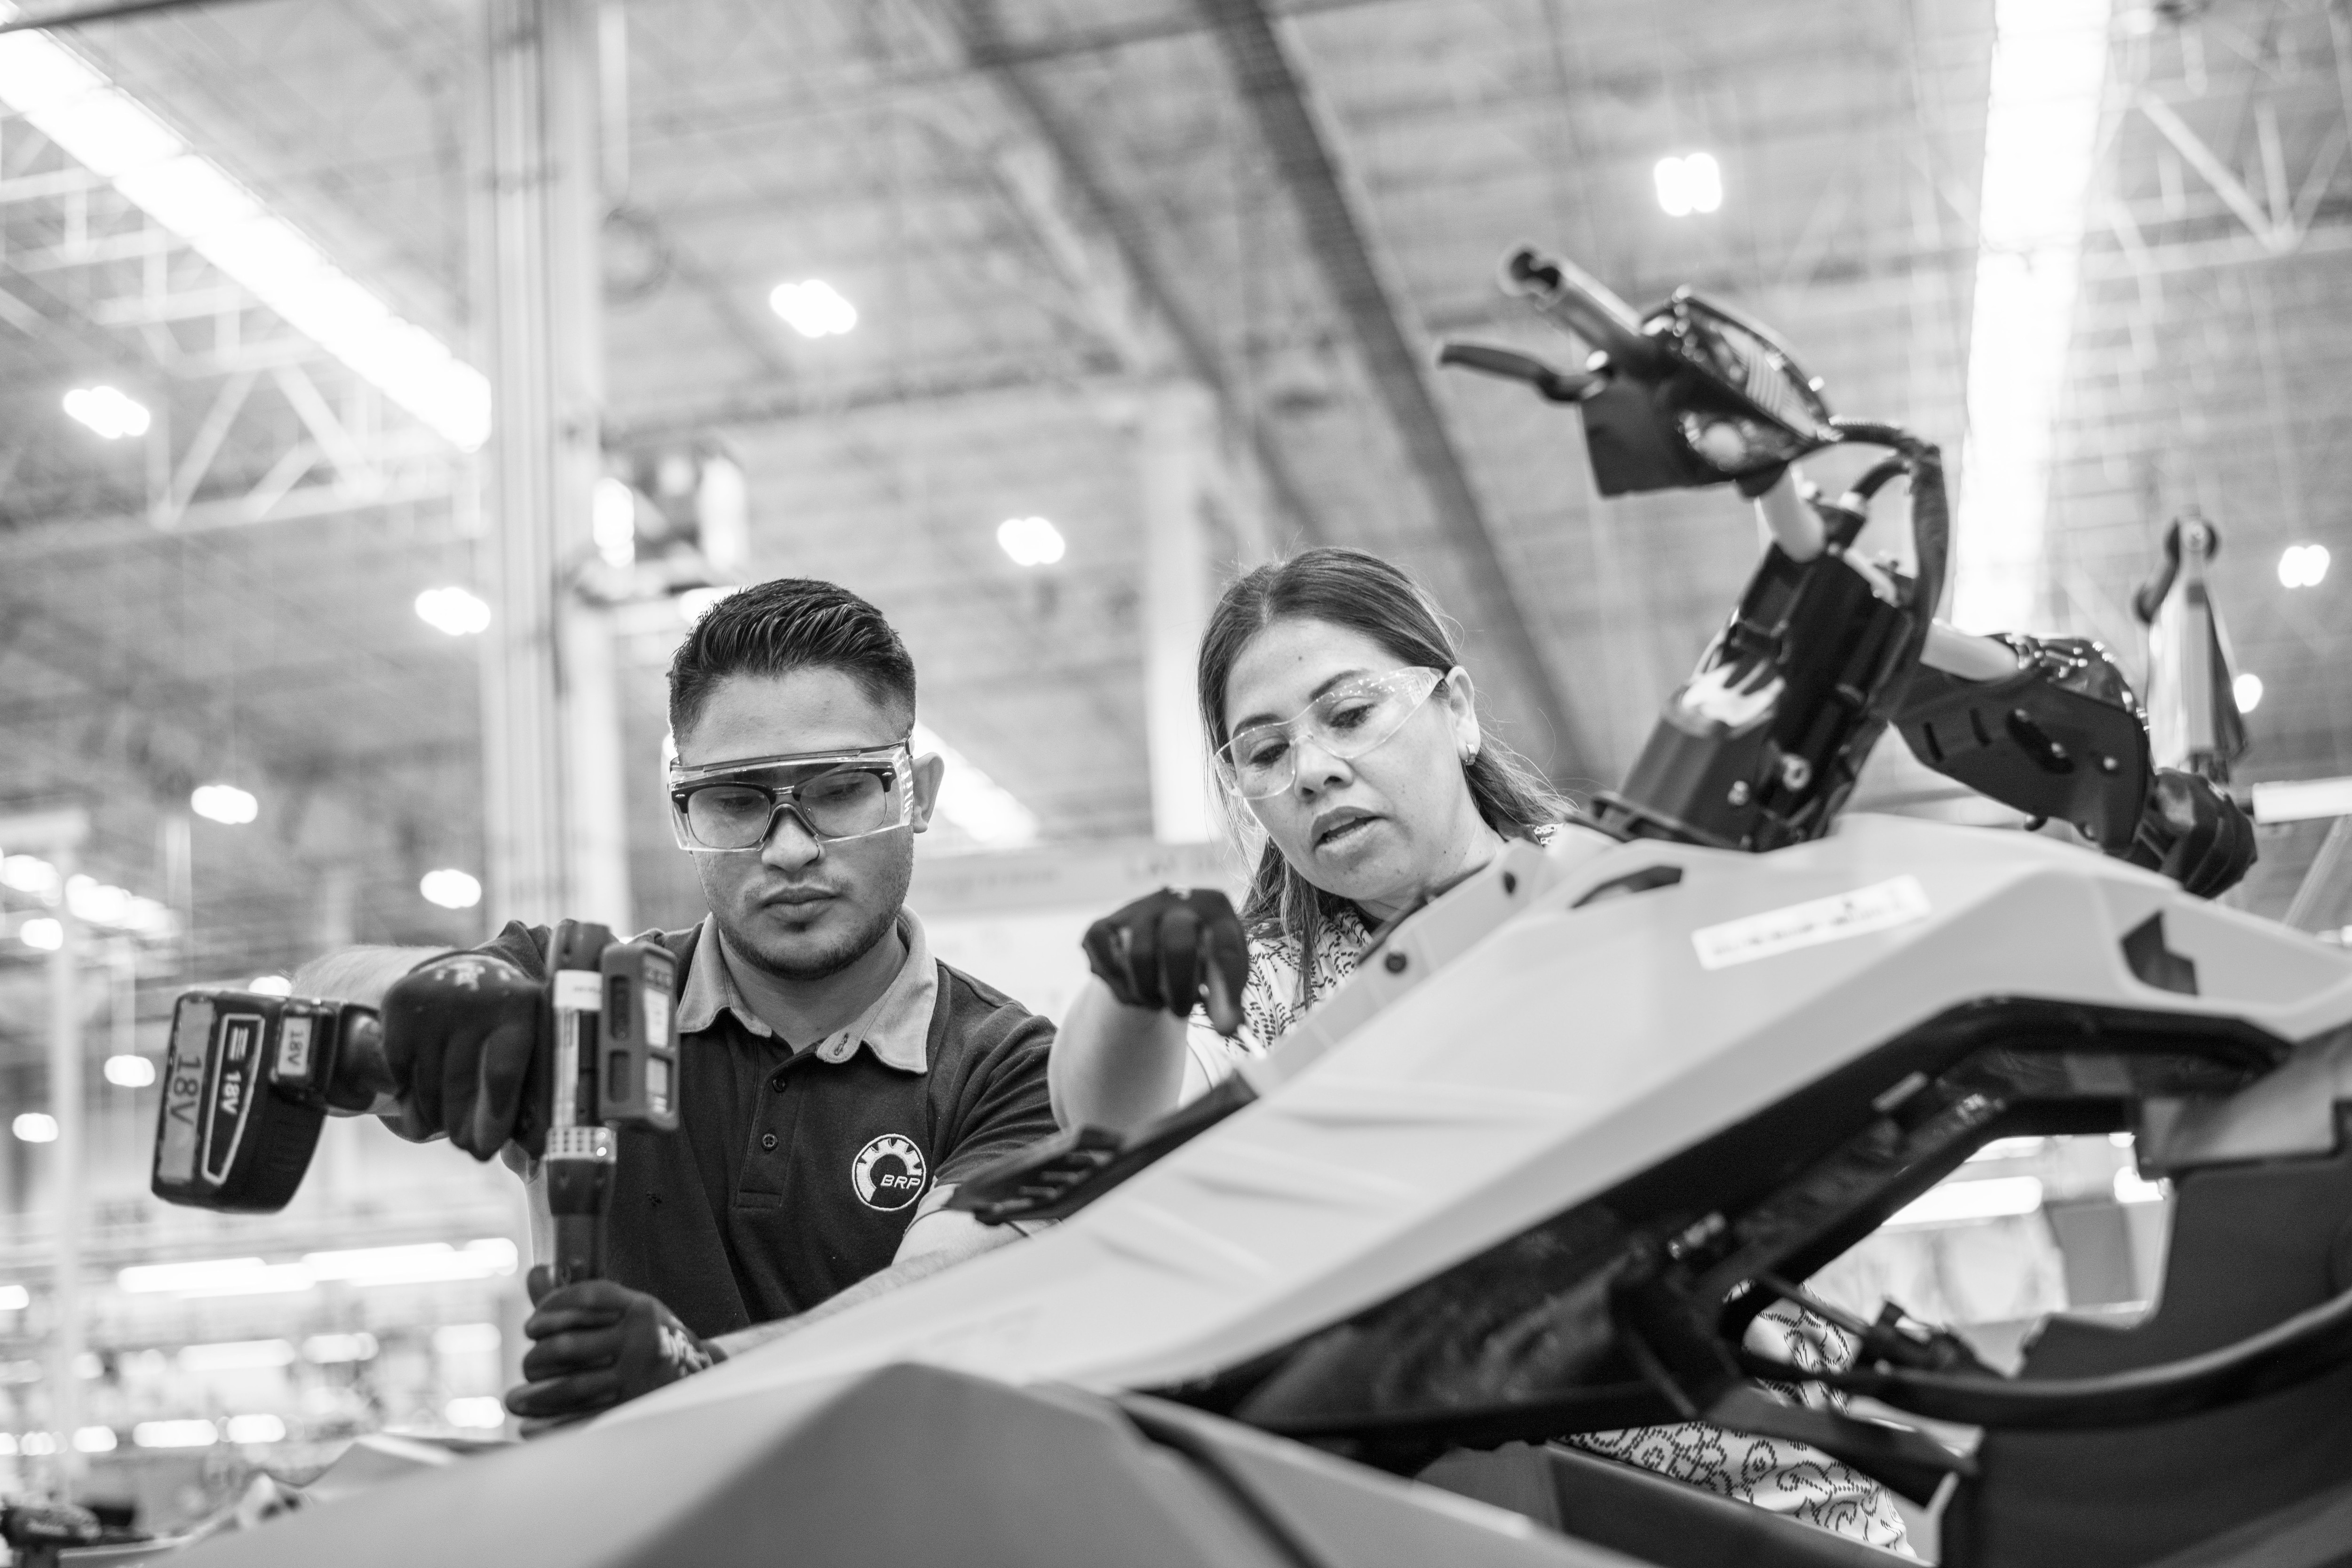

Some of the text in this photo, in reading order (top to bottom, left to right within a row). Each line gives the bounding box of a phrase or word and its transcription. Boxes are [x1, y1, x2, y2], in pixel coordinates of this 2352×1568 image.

[287, 1030, 303, 1066] 18V
[170, 1055, 201, 1125] 18V
[221, 1071, 241, 1114] 18V
[880, 1174, 921, 1189] BRP
